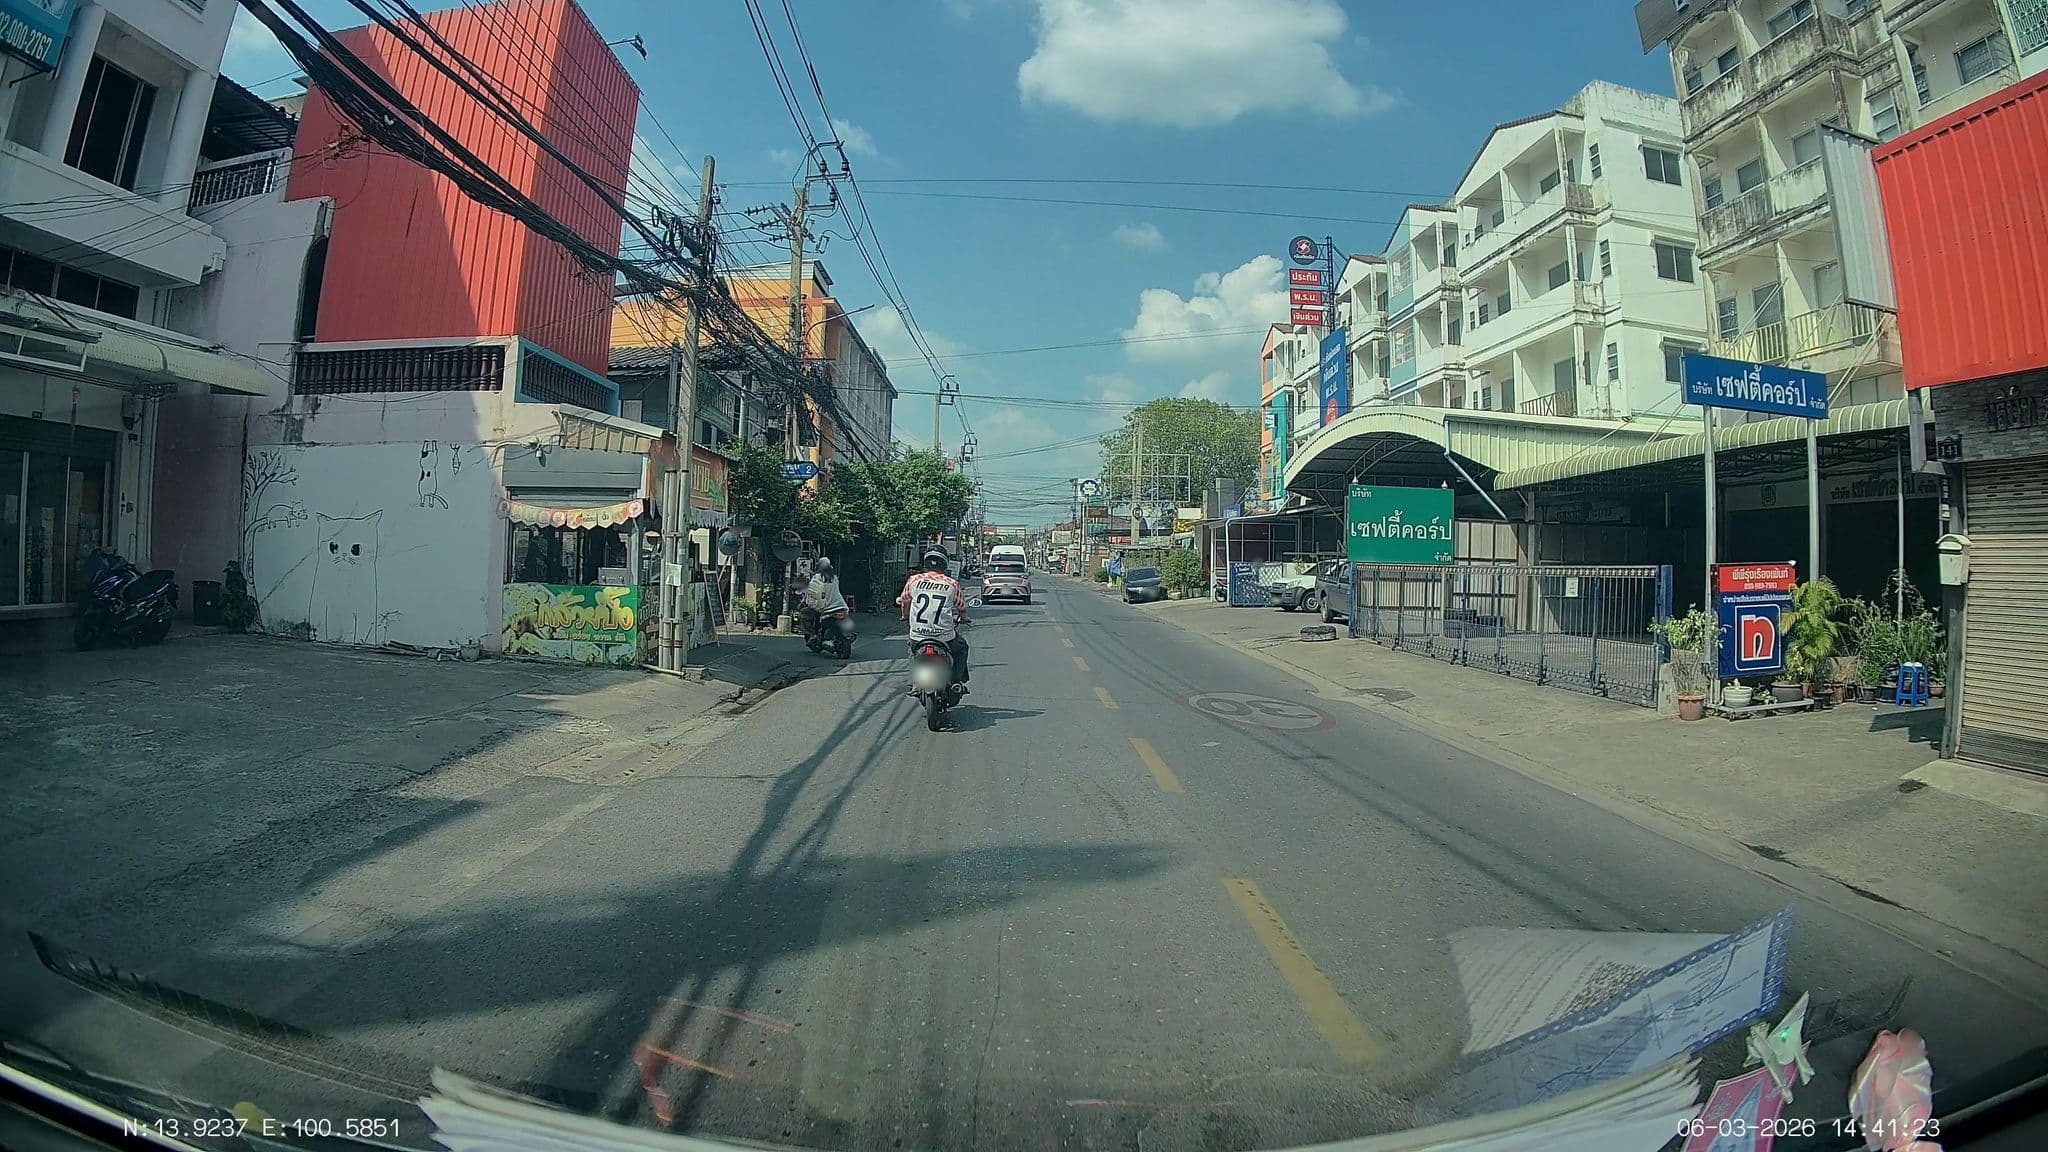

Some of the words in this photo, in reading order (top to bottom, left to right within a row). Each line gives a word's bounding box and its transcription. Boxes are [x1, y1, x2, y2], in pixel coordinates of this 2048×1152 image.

[1292, 272, 1317, 282] ประกัน
[1293, 293, 1317, 301] พ.ร.บ.
[1294, 312, 1319, 321] เงินด่วน
[1692, 381, 1713, 395] บริษัท
[1716, 365, 1806, 407] เซฟตี้คอร์ป
[1810, 397, 1826, 409] จำกัด
[806, 465, 812, 474] 2
[1352, 488, 1372, 498] บริษัท
[1351, 510, 1452, 541] เซฟตี้คอร์ป
[1434, 552, 1452, 562] จำกัด
[916, 593, 947, 625] 27
